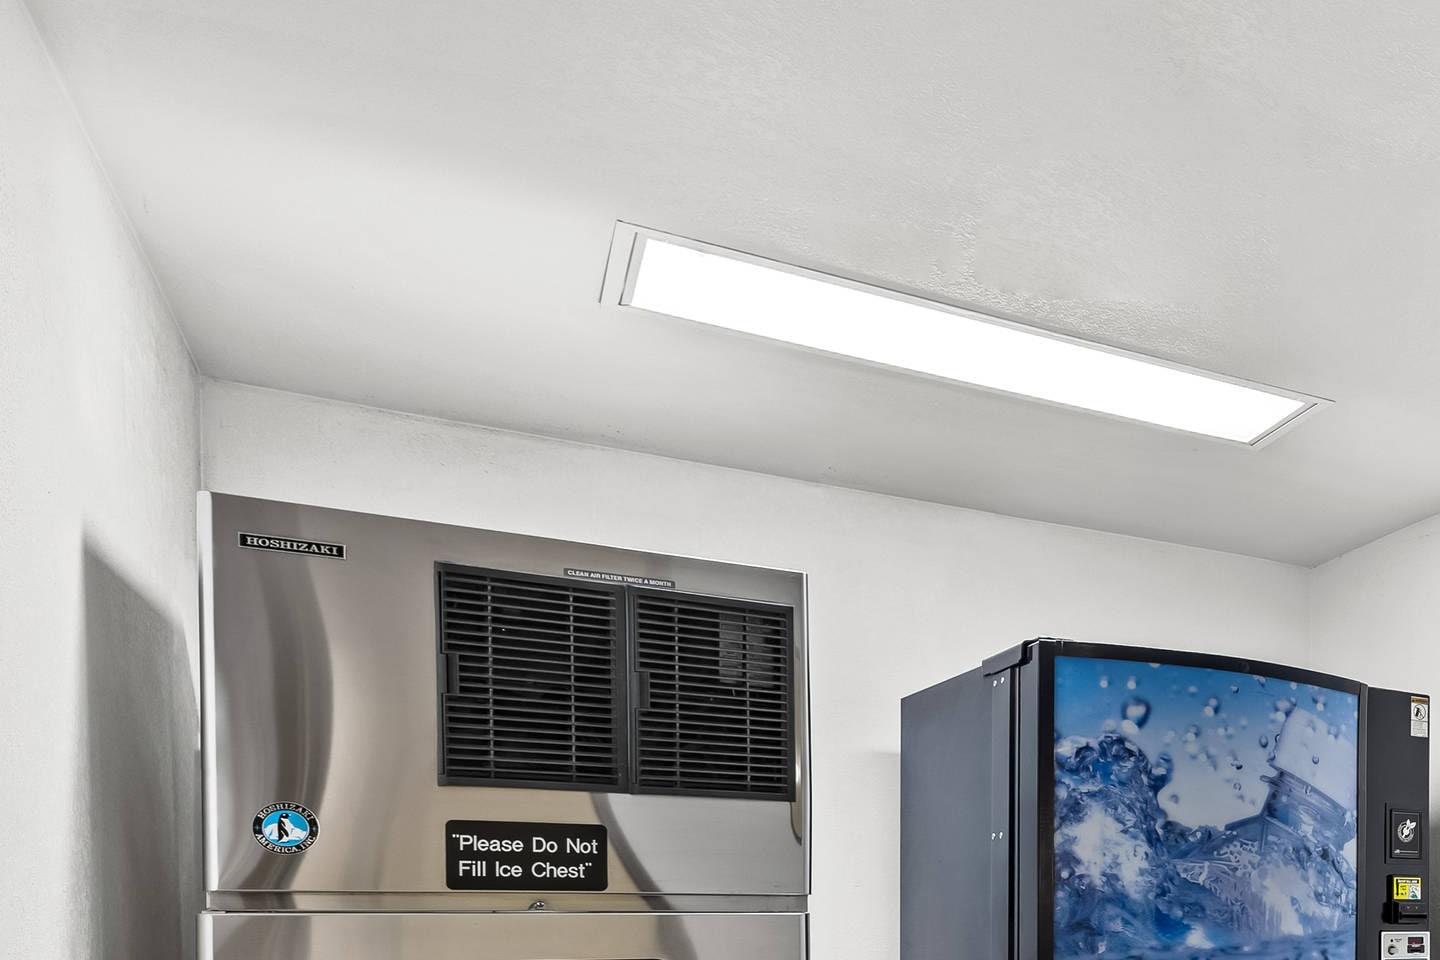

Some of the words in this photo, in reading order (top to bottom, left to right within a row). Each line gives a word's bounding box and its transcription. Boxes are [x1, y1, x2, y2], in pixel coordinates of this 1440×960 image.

[245, 536, 339, 556] HOSHIZAKI
[567, 569, 589, 577] CLEAN
[602, 574, 623, 582] FILTER
[624, 576, 643, 584] TWICE
[257, 803, 315, 820] HOSHIZAKI
[532, 836, 558, 854] Do
[566, 838, 599, 854] Not
[458, 860, 487, 877] Fill
[495, 861, 523, 878] Ice
